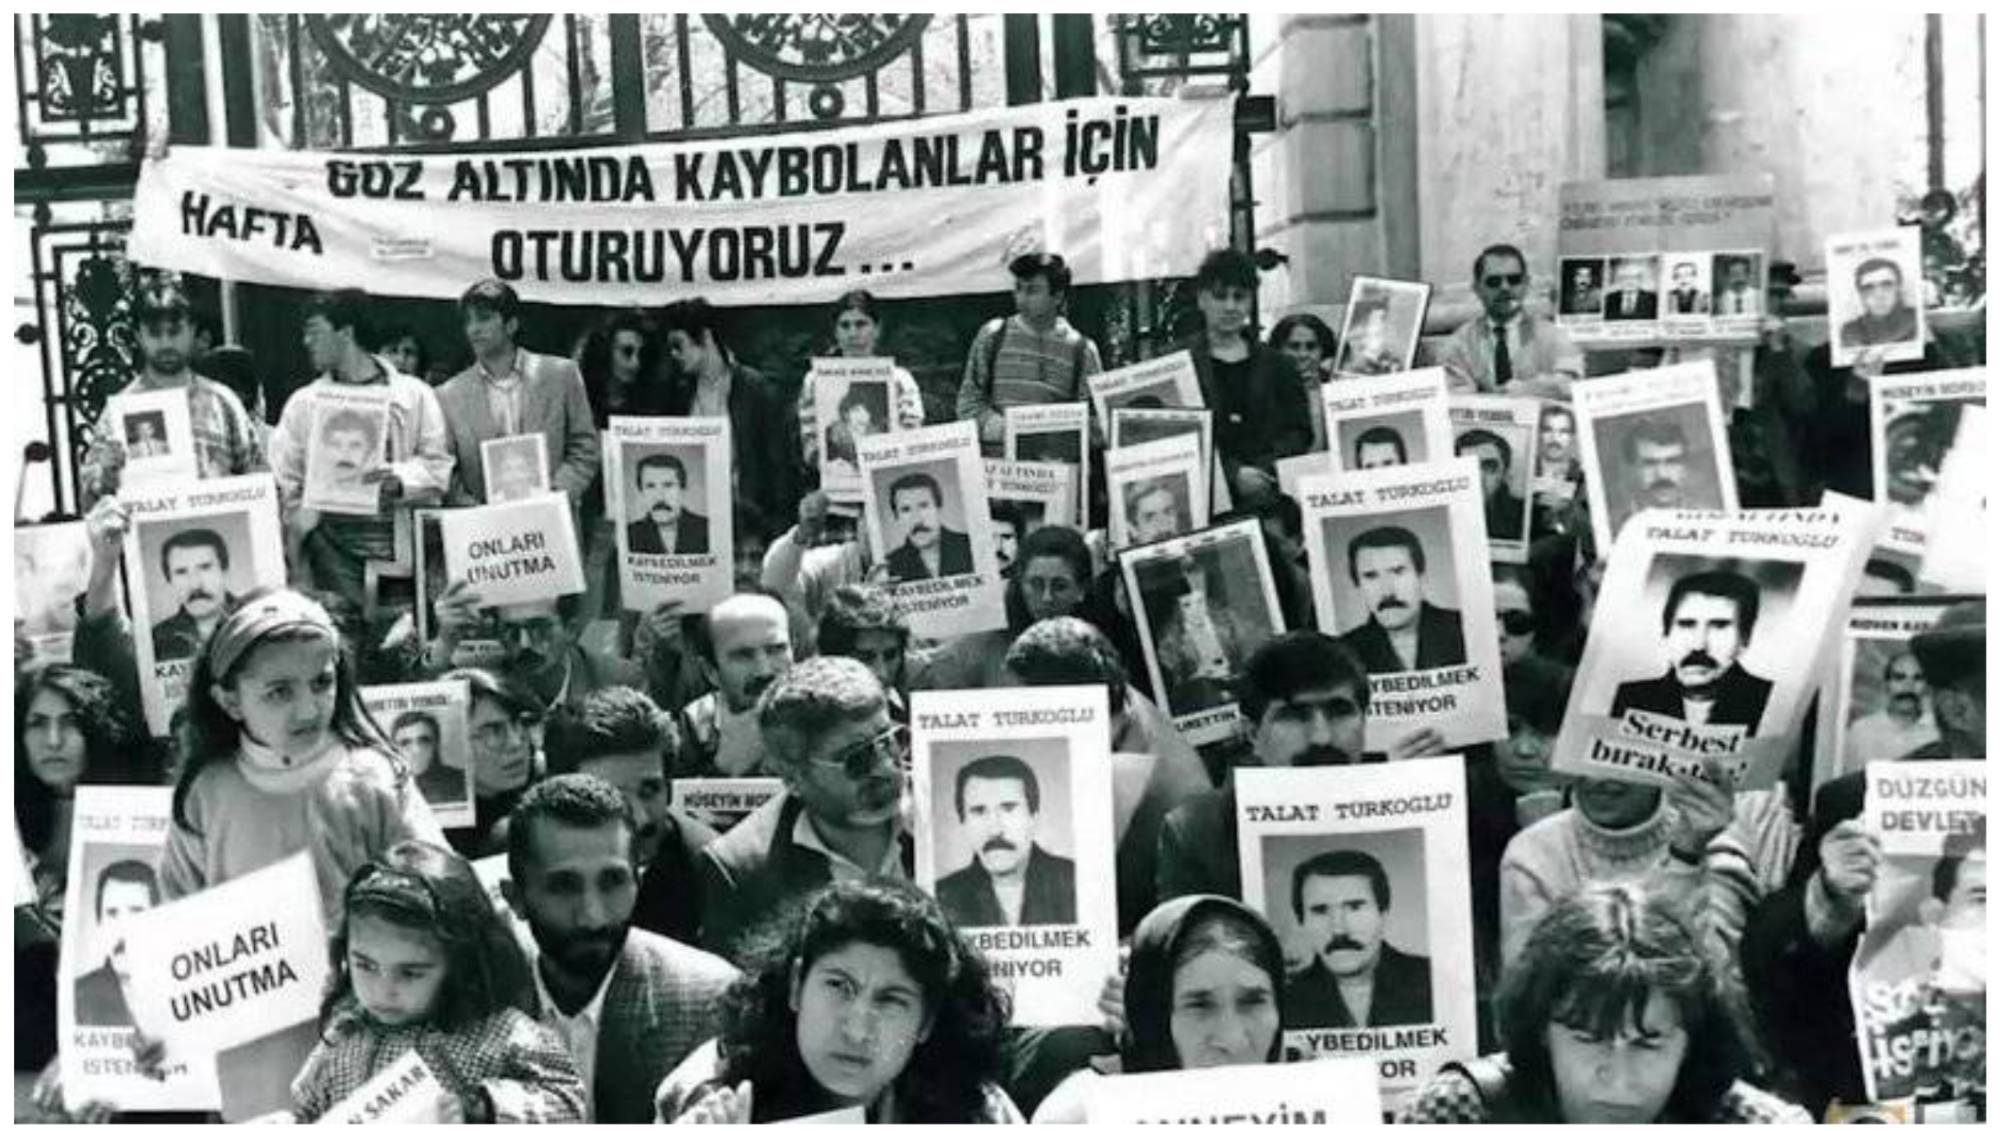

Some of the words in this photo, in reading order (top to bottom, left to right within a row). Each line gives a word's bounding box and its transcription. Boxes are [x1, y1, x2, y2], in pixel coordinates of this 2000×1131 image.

[448, 154, 655, 201] ALTINDA
[674, 126, 1044, 200] KAYBOLANLAR
[1064, 105, 1158, 186] İÇİN
[181, 190, 323, 255] HAFTA
[468, 530, 545, 560] ONLARI
[467, 555, 556, 584] UNUTMA
[917, 711, 981, 730] TALAT
[1245, 803, 1320, 822] TALAT
[171, 922, 280, 981] ONLARI
[171, 959, 299, 1021] UNUTMA
